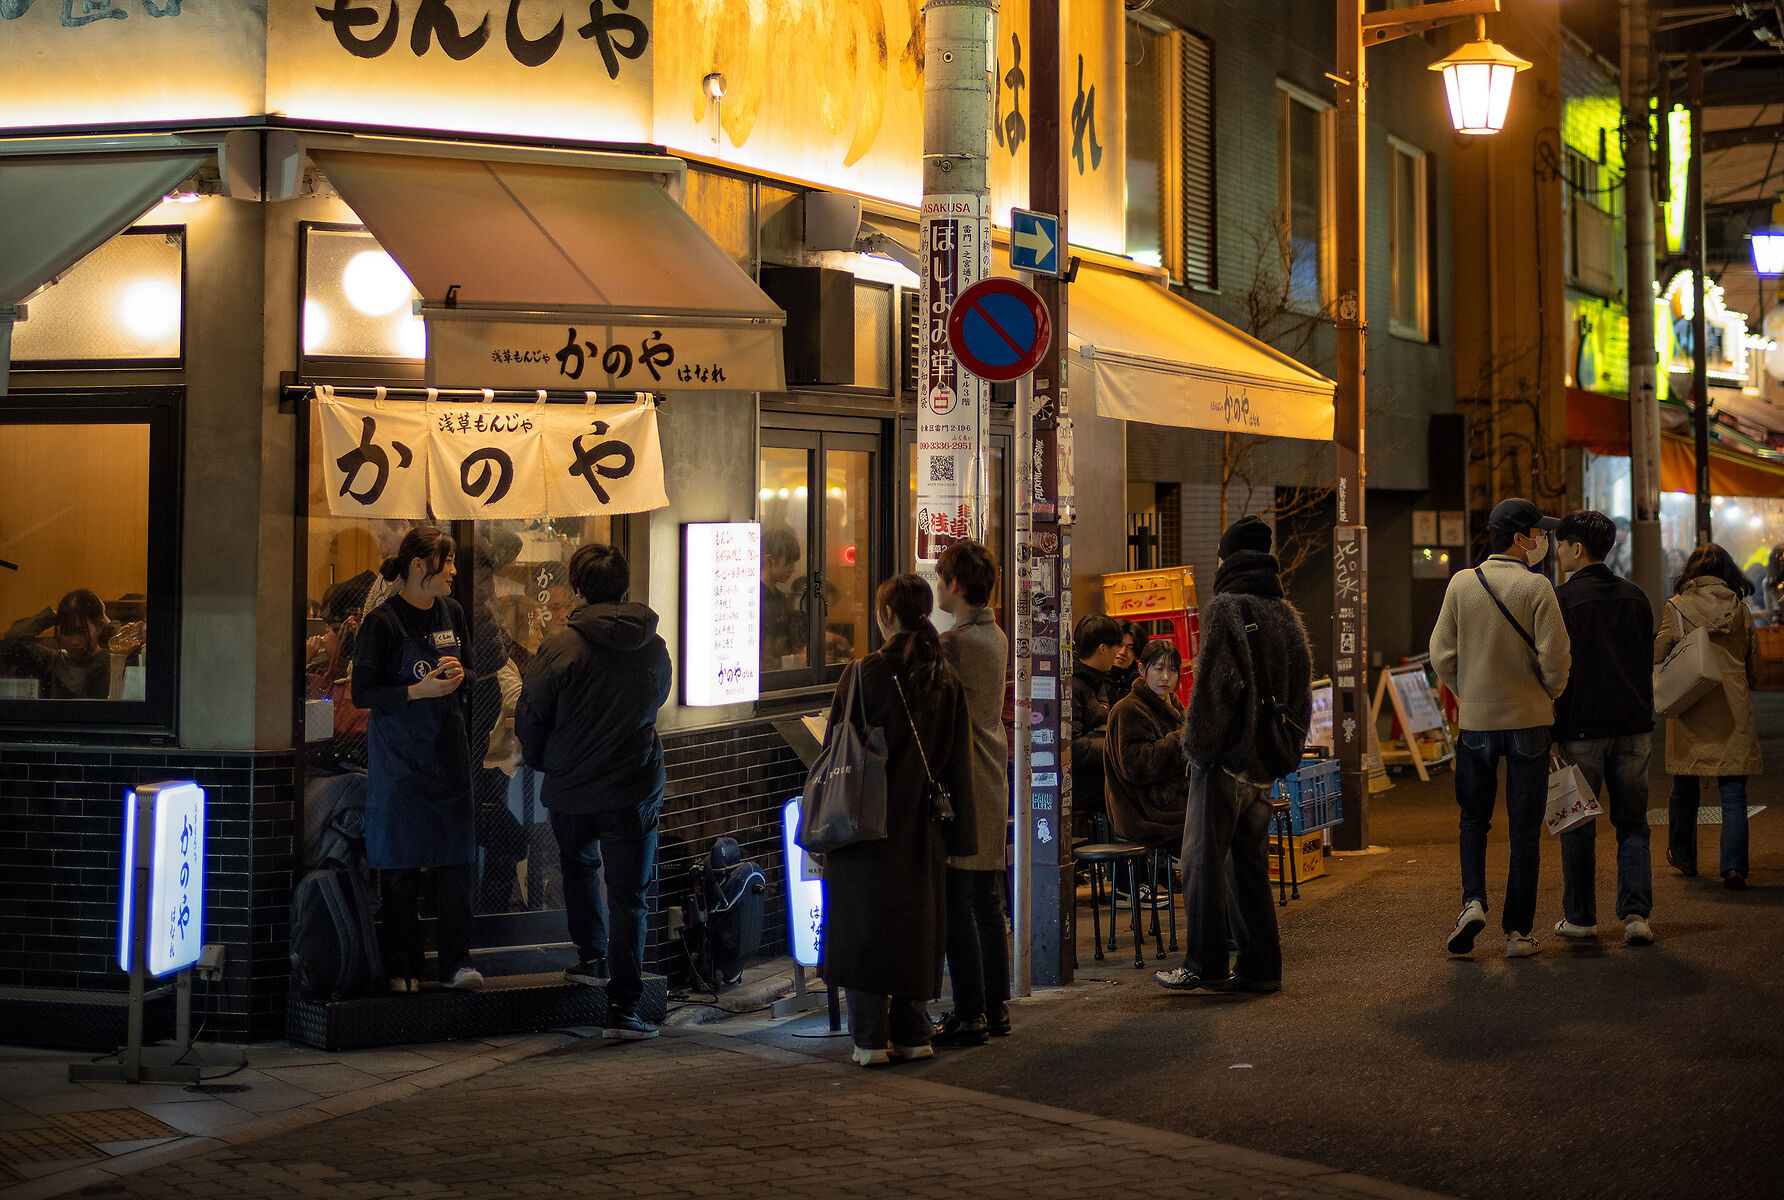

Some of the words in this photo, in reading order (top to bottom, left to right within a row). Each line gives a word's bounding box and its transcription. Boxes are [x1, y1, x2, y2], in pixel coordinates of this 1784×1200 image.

[924, 203, 971, 213] ASAKUSA
[930, 224, 955, 377] ほしよみ堂
[491, 349, 550, 363] 浅草もんじゃ
[555, 327, 675, 381] かのや
[677, 364, 726, 382] はなれ
[438, 413, 534, 434] 浅草もんじゃ
[336, 416, 636, 507] かのや
[537, 567, 553, 628] かのや
[1121, 594, 1166, 609] ホッピー
[717, 661, 741, 685] かのや
[177, 814, 193, 941] かのや
